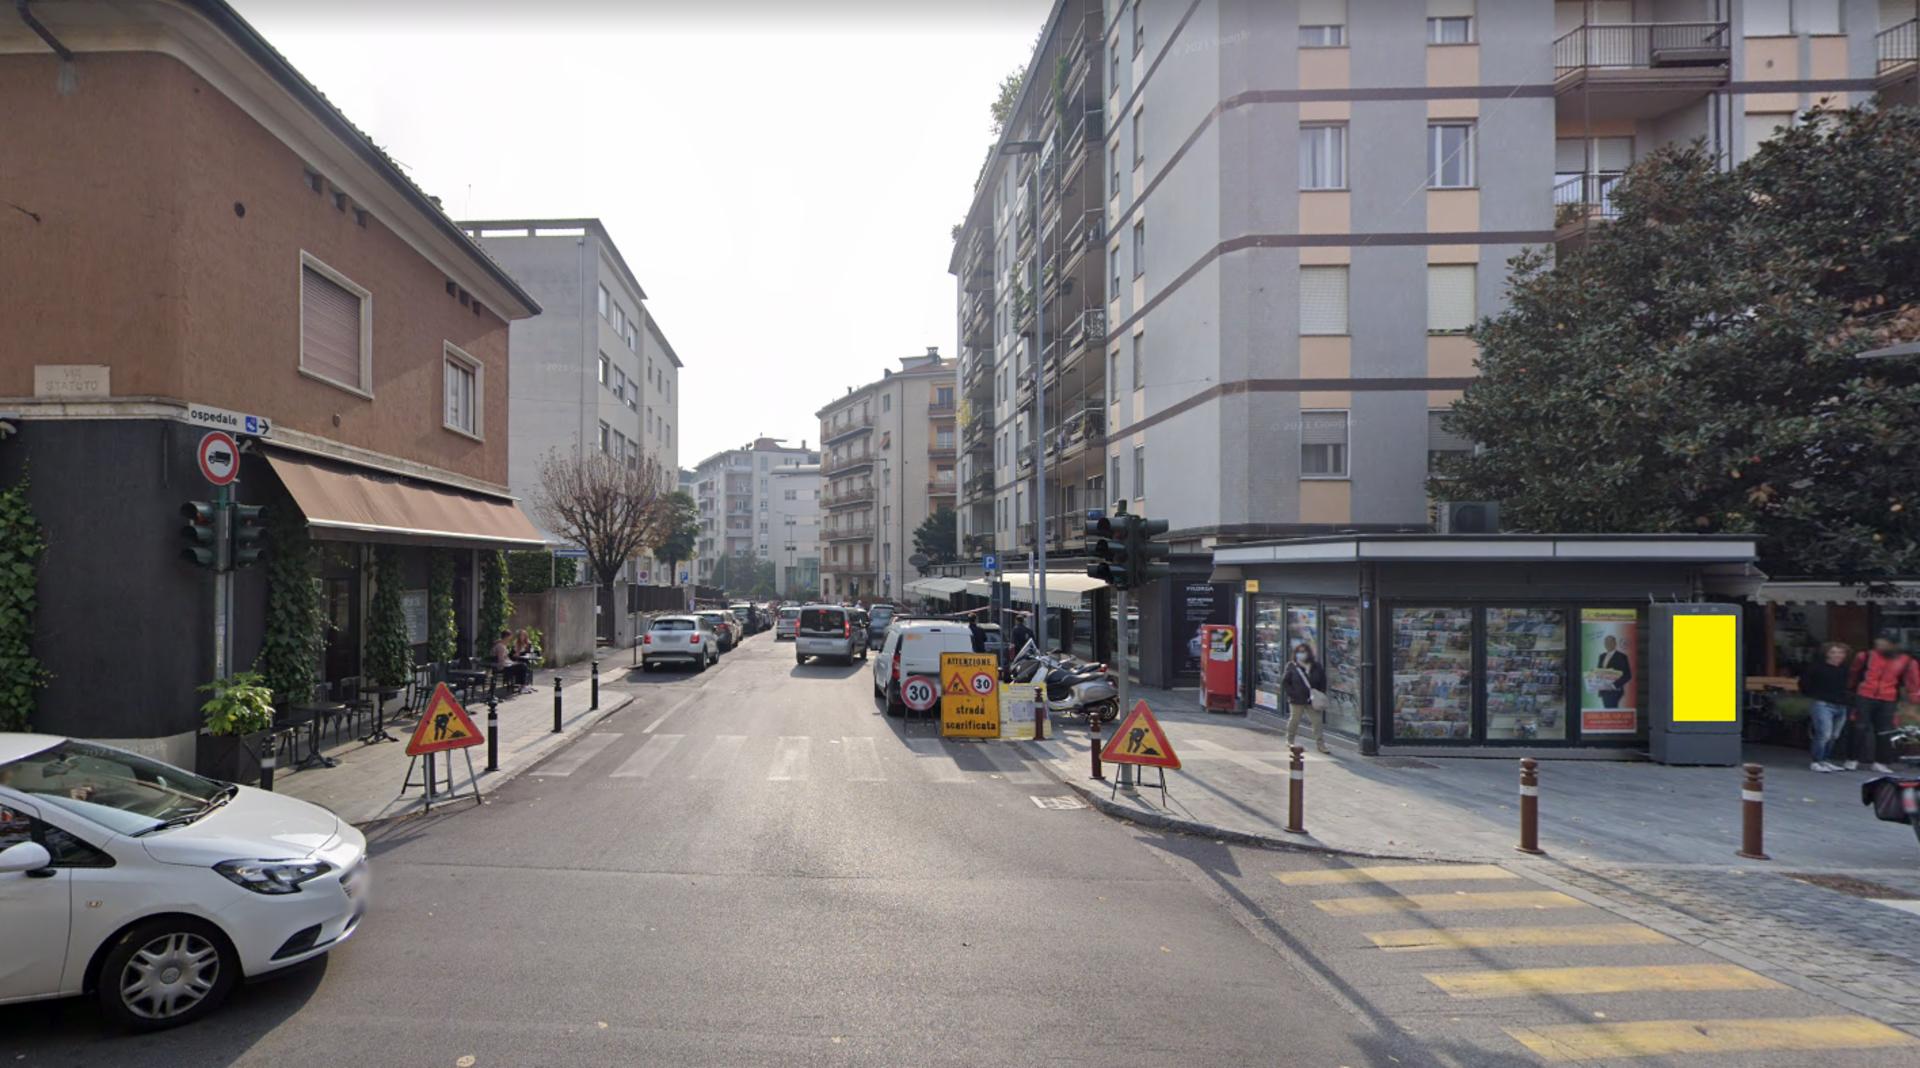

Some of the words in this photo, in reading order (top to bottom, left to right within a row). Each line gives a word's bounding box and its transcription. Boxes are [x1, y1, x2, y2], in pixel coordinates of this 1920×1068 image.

[47, 380, 97, 391] STATUTO
[191, 410, 237, 425] ospedale
[1856, 588, 1920, 599] fotosudio
[947, 658, 992, 666] ATTENZIONE
[976, 678, 990, 689] 30
[909, 685, 930, 701] 30
[956, 705, 985, 715] strada
[946, 721, 996, 731] scarificata
